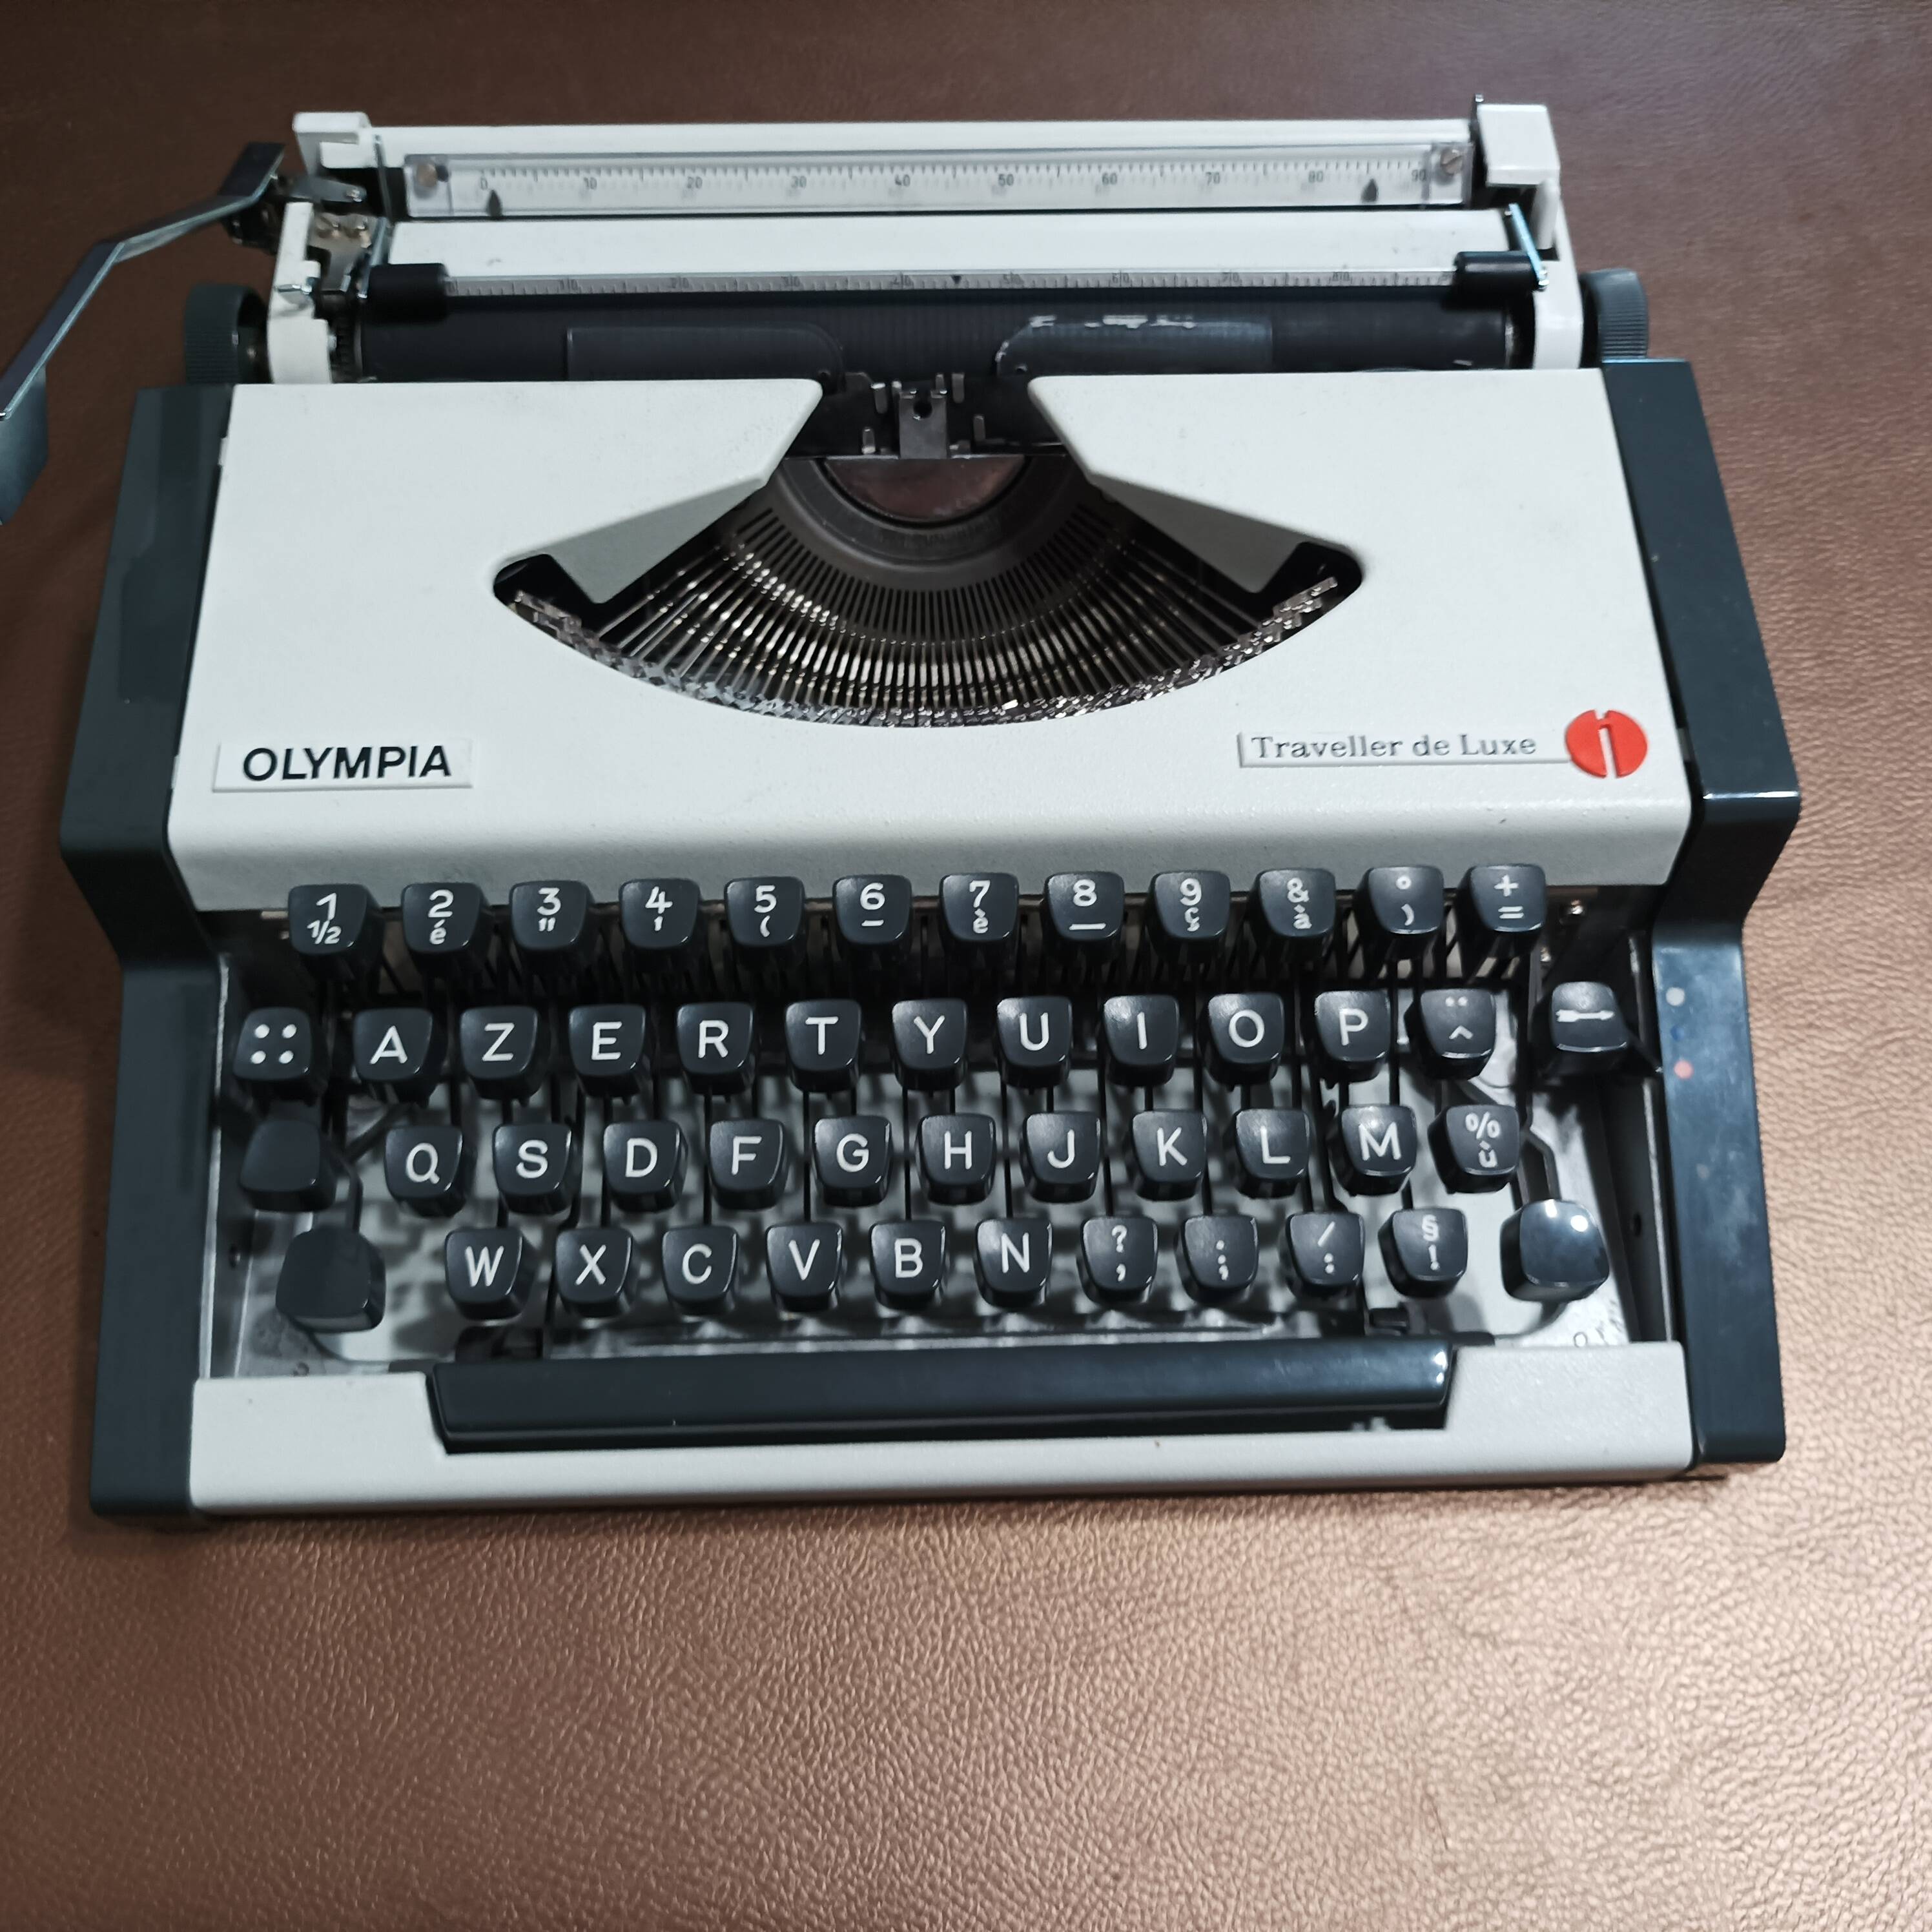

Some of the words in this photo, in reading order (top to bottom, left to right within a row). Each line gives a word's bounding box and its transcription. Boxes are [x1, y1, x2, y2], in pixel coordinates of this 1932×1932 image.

[583, 176, 597, 190] 10
[687, 176, 703, 189] 20
[790, 175, 807, 189] 30
[894, 174, 910, 187] 40
[998, 173, 1014, 187] 50
[1102, 172, 1118, 186] 60
[1206, 171, 1221, 185] 70
[1308, 170, 1324, 183] 80
[1412, 169, 1426, 181] 90
[1251, 734, 1403, 759] Traveller
[1412, 734, 1451, 757] de
[1460, 733, 1537, 756] Luxe
[242, 745, 452, 782] OLYMPIA
[645, 886, 673, 914] 4
[754, 885, 777, 913] 5
[859, 882, 885, 910] 6
[969, 880, 991, 908] 7
[1073, 879, 1097, 907] 8
[1180, 878, 1202, 906] 9
[1286, 878, 1310, 903] &
[1494, 874, 1519, 897] +
[316, 892, 337, 921] 1
[428, 889, 454, 918] 2
[537, 887, 561, 916] 3
[1401, 903, 1415, 926] )
[1497, 906, 1524, 919] =
[760, 915, 770, 938] (
[973, 908, 989, 934] è
[1184, 907, 1200, 932] ç
[1293, 904, 1312, 929] à
[429, 919, 447, 945] é
[591, 1022, 622, 1060] E
[698, 1020, 729, 1058] R
[805, 1016, 839, 1055] T
[913, 1015, 945, 1054] Y
[1019, 1011, 1050, 1052] U
[1136, 1011, 1147, 1050] I
[1228, 1009, 1266, 1049] O
[1338, 1007, 1370, 1047] P
[370, 1025, 407, 1064] A
[482, 1022, 515, 1062] Z
[1465, 1111, 1501, 1139] %
[731, 1136, 762, 1175] F
[836, 1133, 869, 1172] G
[944, 1131, 972, 1169] H
[1047, 1128, 1076, 1169] J
[1156, 1127, 1187, 1166] K
[1260, 1125, 1291, 1165] L
[1357, 1121, 1403, 1162] M
[1478, 1140, 1498, 1168] ù
[406, 1142, 440, 1184] Q
[516, 1140, 548, 1178] S
[625, 1138, 657, 1178] D
[1111, 1225, 1127, 1253] ?
[1317, 1221, 1335, 1247] /
[1422, 1214, 1440, 1242] §
[464, 1246, 504, 1287] W
[575, 1244, 606, 1285] X
[682, 1244, 712, 1284] C
[788, 1239, 820, 1280] V
[894, 1238, 923, 1278] B
[1001, 1231, 1031, 1274] N
[1324, 1253, 1335, 1273] :
[1428, 1244, 1439, 1270] !
[1116, 1264, 1126, 1282] ,
[1218, 1255, 1229, 1280] ;
